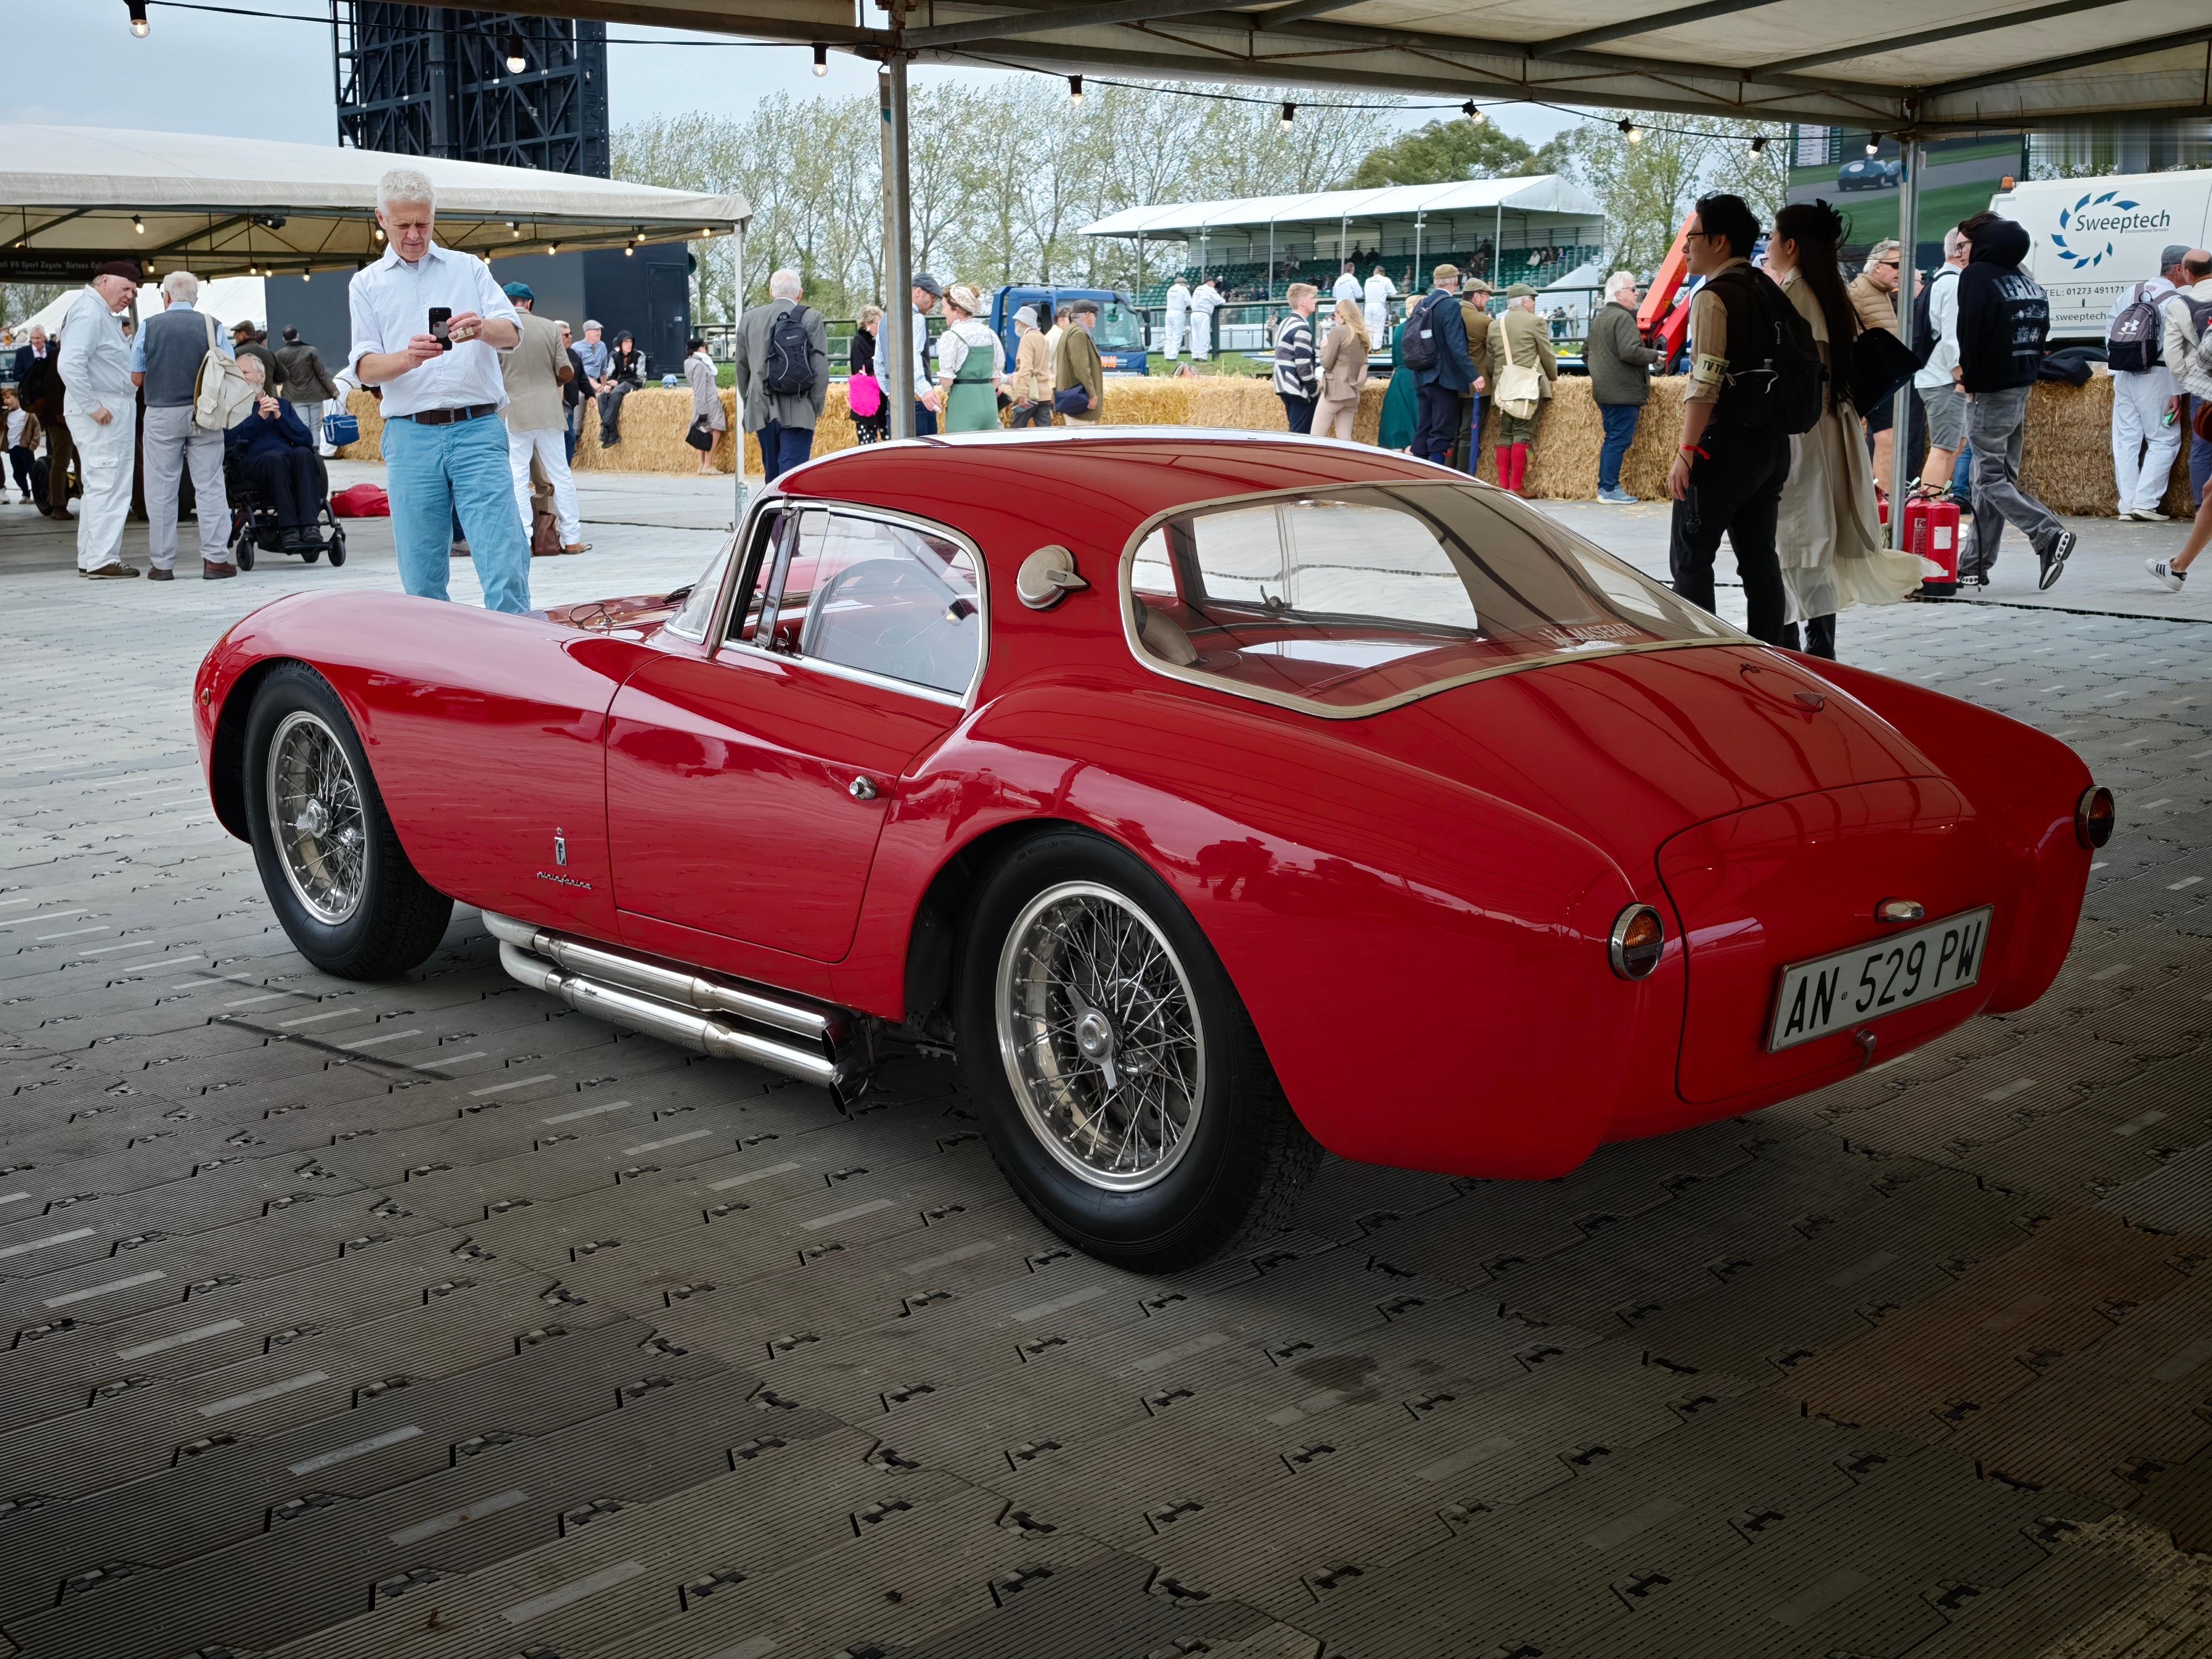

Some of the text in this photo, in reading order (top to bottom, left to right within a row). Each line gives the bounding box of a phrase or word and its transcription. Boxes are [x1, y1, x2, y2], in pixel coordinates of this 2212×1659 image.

[2075, 210, 2170, 233] Sweeptech
[2066, 287, 2092, 295] 01273
[1784, 922, 1981, 1037] AN 529 PW
